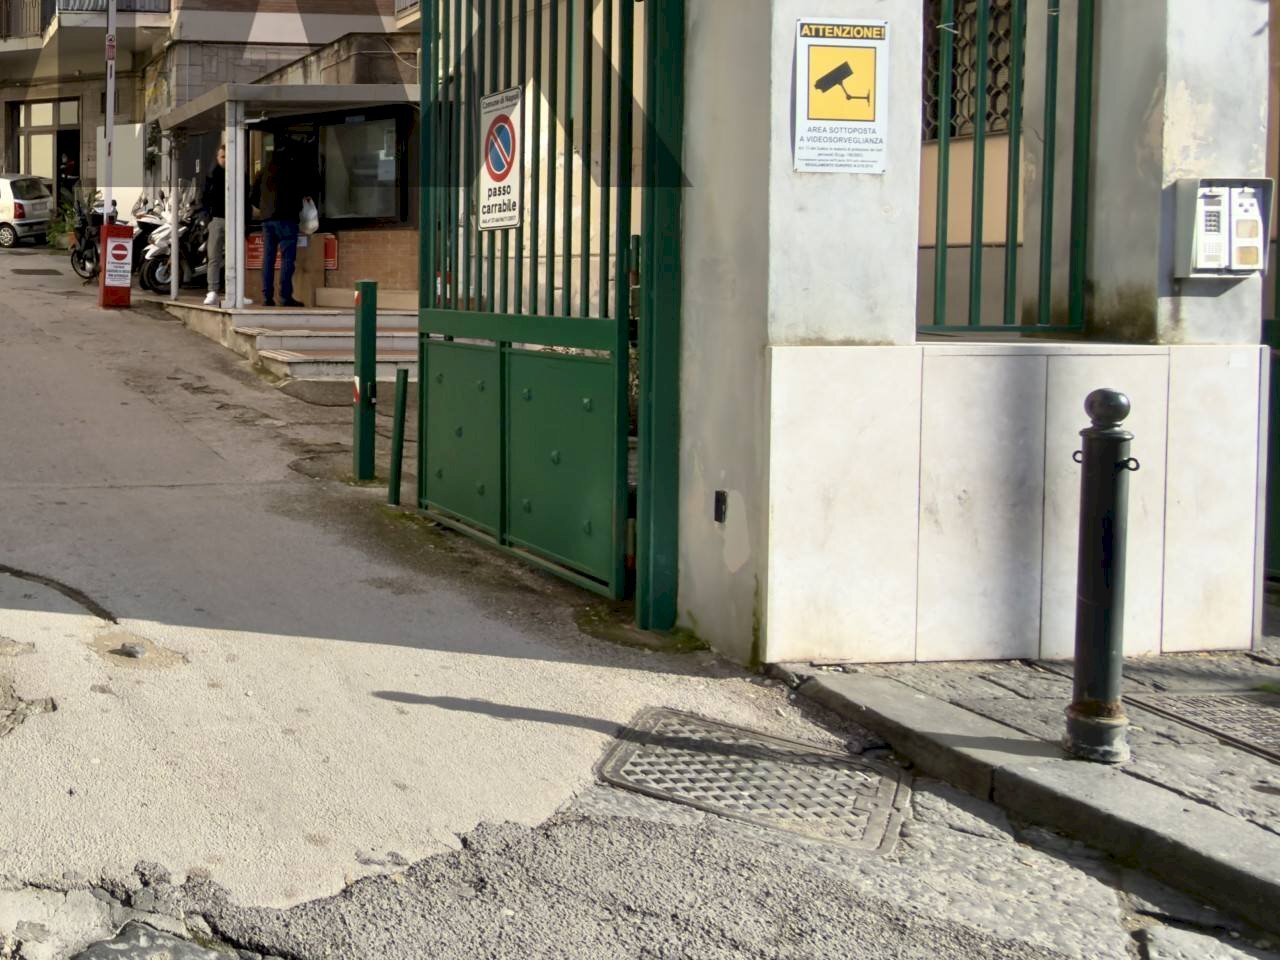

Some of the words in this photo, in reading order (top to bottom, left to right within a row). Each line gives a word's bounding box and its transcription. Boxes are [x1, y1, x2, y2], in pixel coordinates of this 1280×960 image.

[807, 126, 827, 134] AREA
[829, 127, 877, 135] SOTTOPOSTA
[807, 136, 884, 144] VIDEOSORVEGLIANZA
[487, 185, 511, 200] passo
[481, 199, 517, 215] carrabile
